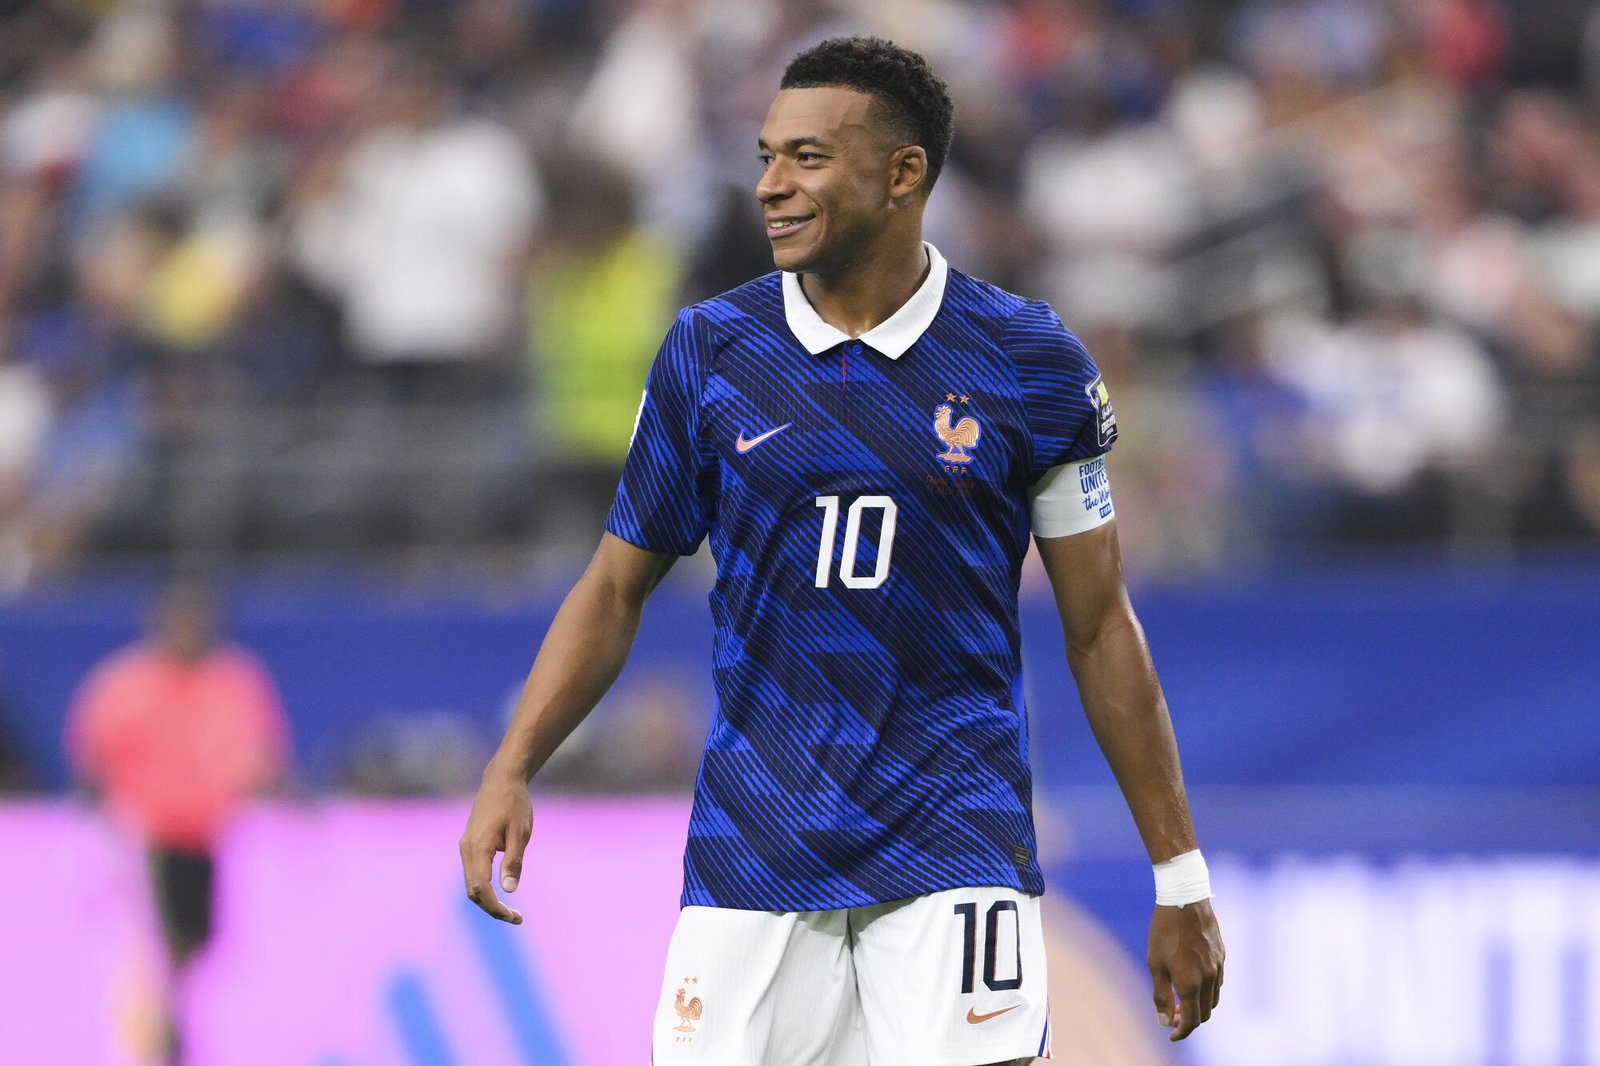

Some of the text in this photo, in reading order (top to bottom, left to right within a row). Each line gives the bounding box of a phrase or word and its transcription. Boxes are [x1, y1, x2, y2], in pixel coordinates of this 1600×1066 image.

[814, 495, 898, 590] 10
[1082, 495, 1098, 511] the
[953, 900, 1023, 994] 10
